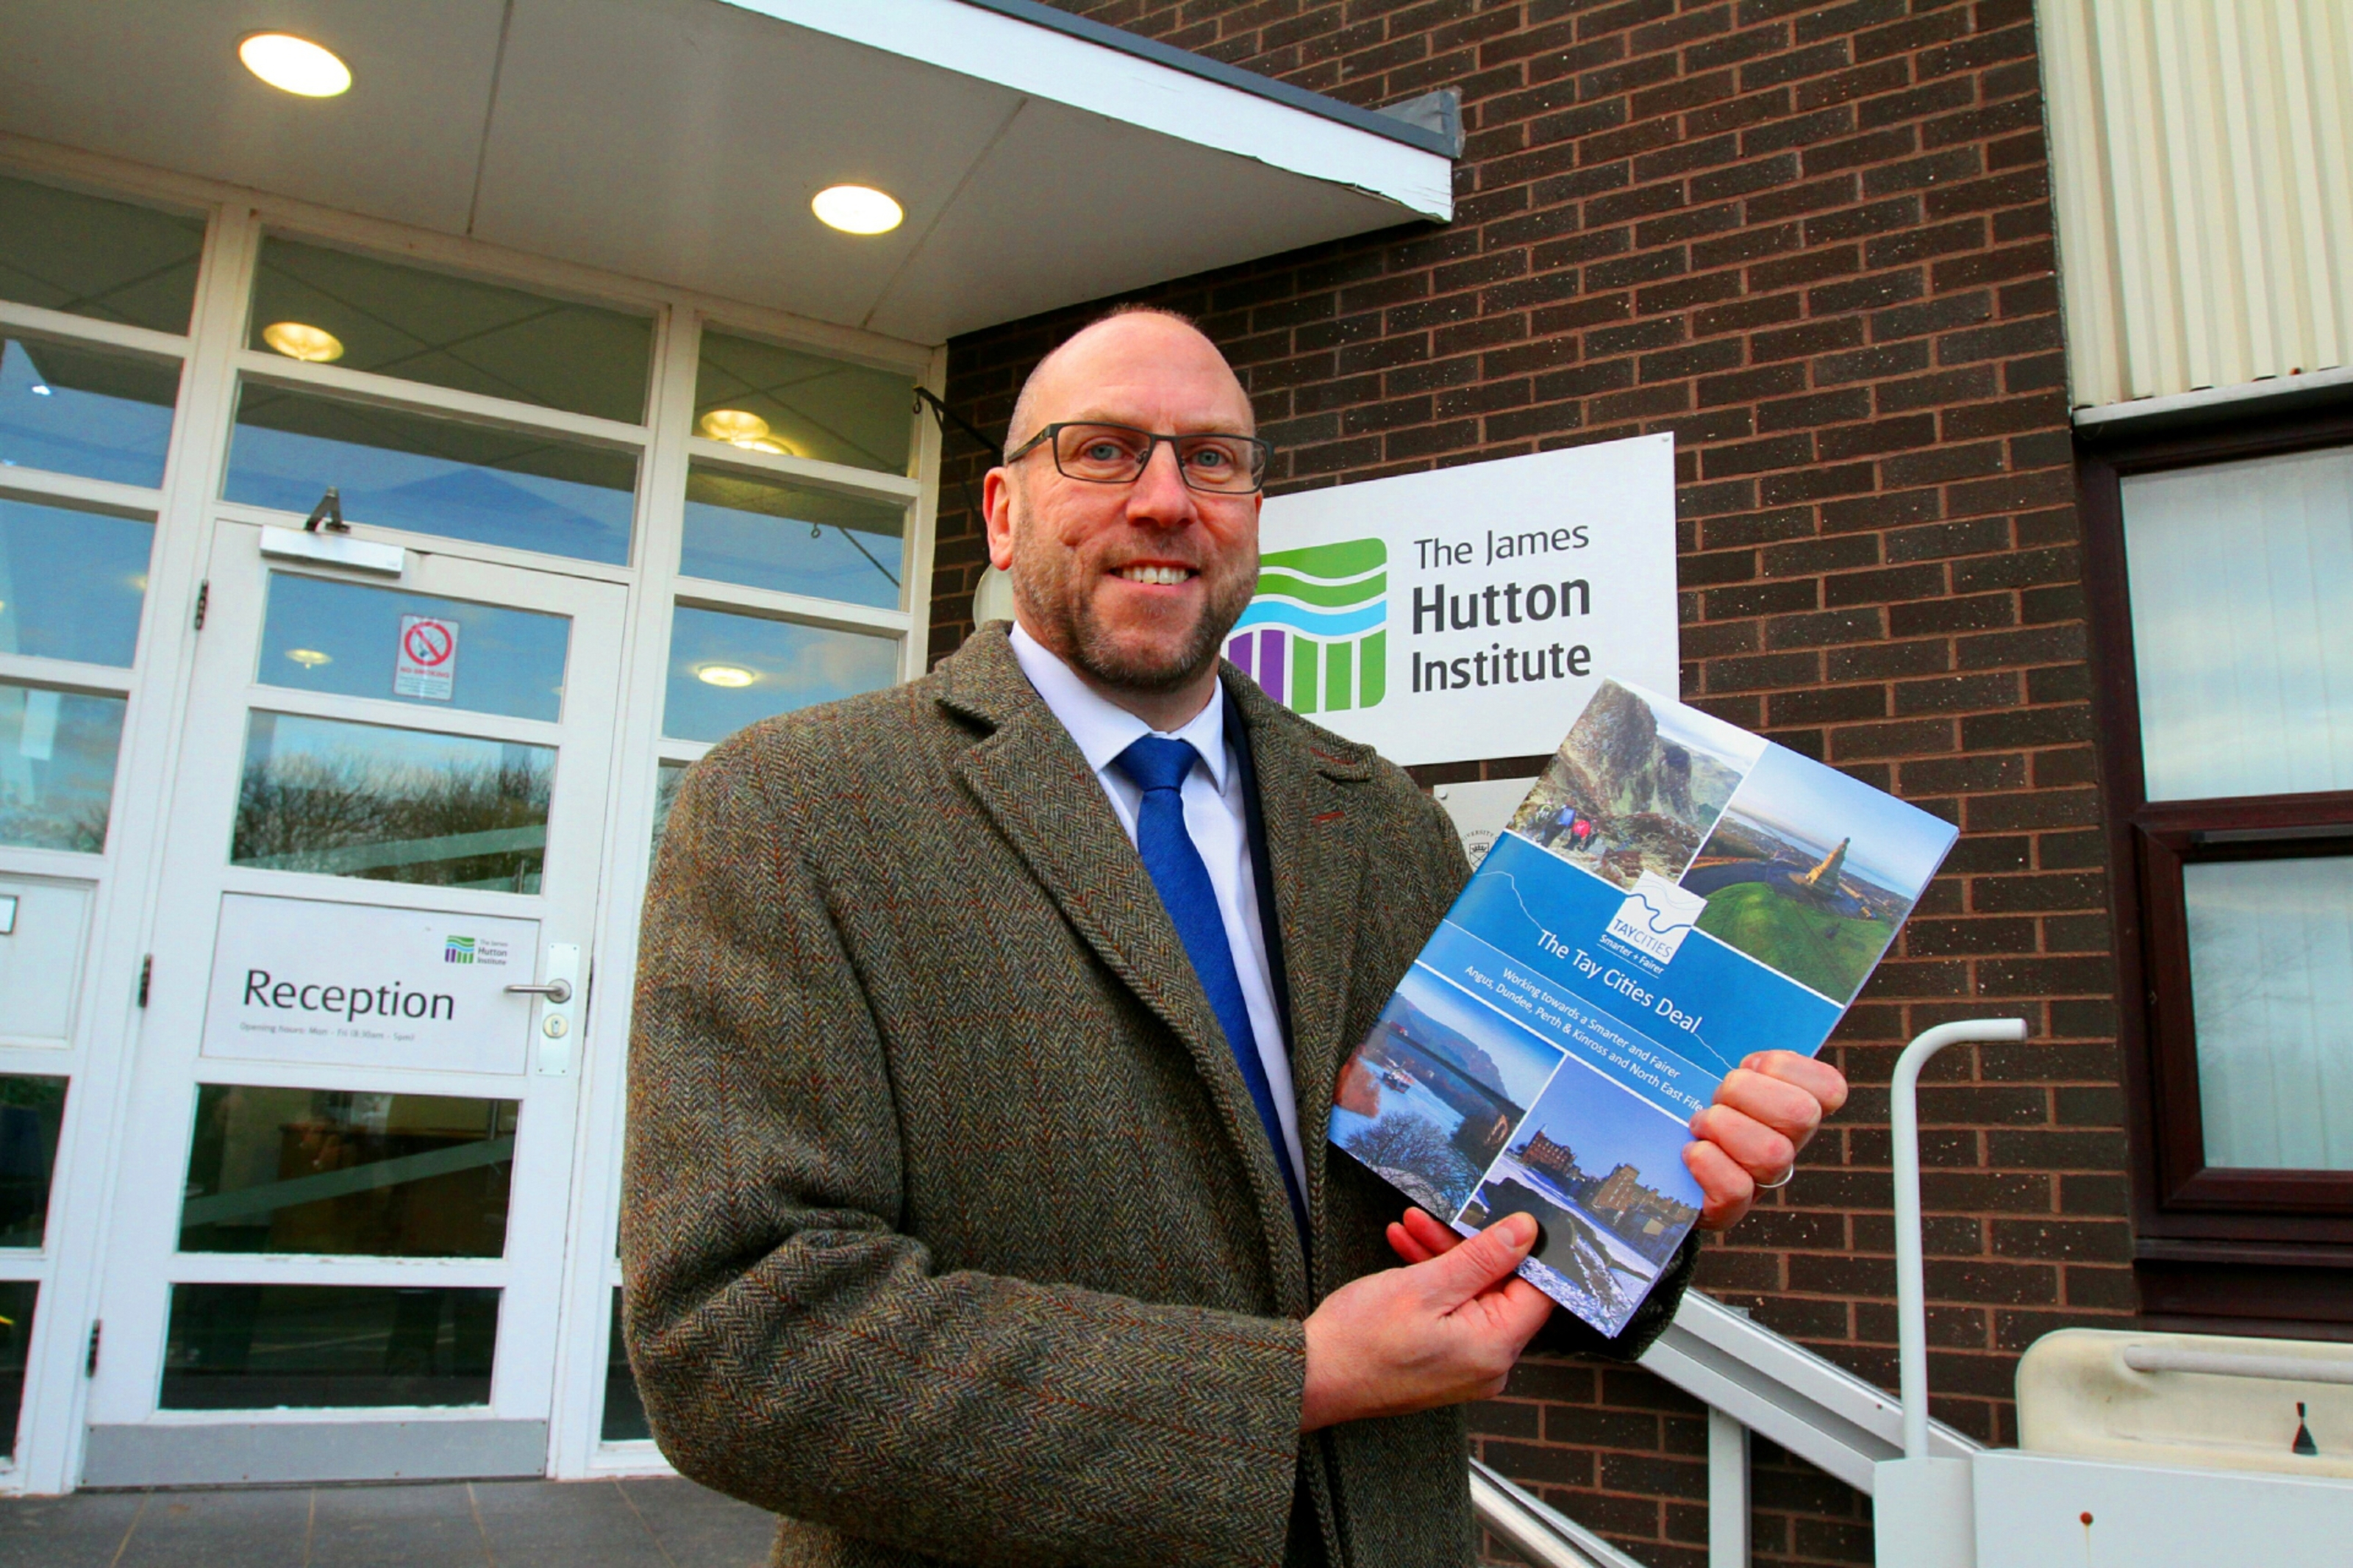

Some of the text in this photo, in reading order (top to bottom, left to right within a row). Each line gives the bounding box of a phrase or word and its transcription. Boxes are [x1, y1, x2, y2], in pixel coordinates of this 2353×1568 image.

[1414, 525, 1589, 569] The James
[1413, 579, 1590, 634] Hutton
[1413, 642, 1591, 692] Institute
[476, 956, 507, 965] Institute
[477, 947, 507, 957] Hutton
[1599, 934, 1633, 956] Smarter
[1638, 956, 1665, 974] Fairer
[1613, 918, 1673, 958] TAYCITIES
[243, 969, 454, 1023] Reception
[1537, 928, 1703, 1034] The Tay Cities Deal
[239, 1022, 276, 1034] Opening
[1465, 965, 1704, 1112] Angus, Dundee, Perth & Kinross and North East Fife
[1502, 967, 1681, 1079] Working towards a Smarter and Fairer
